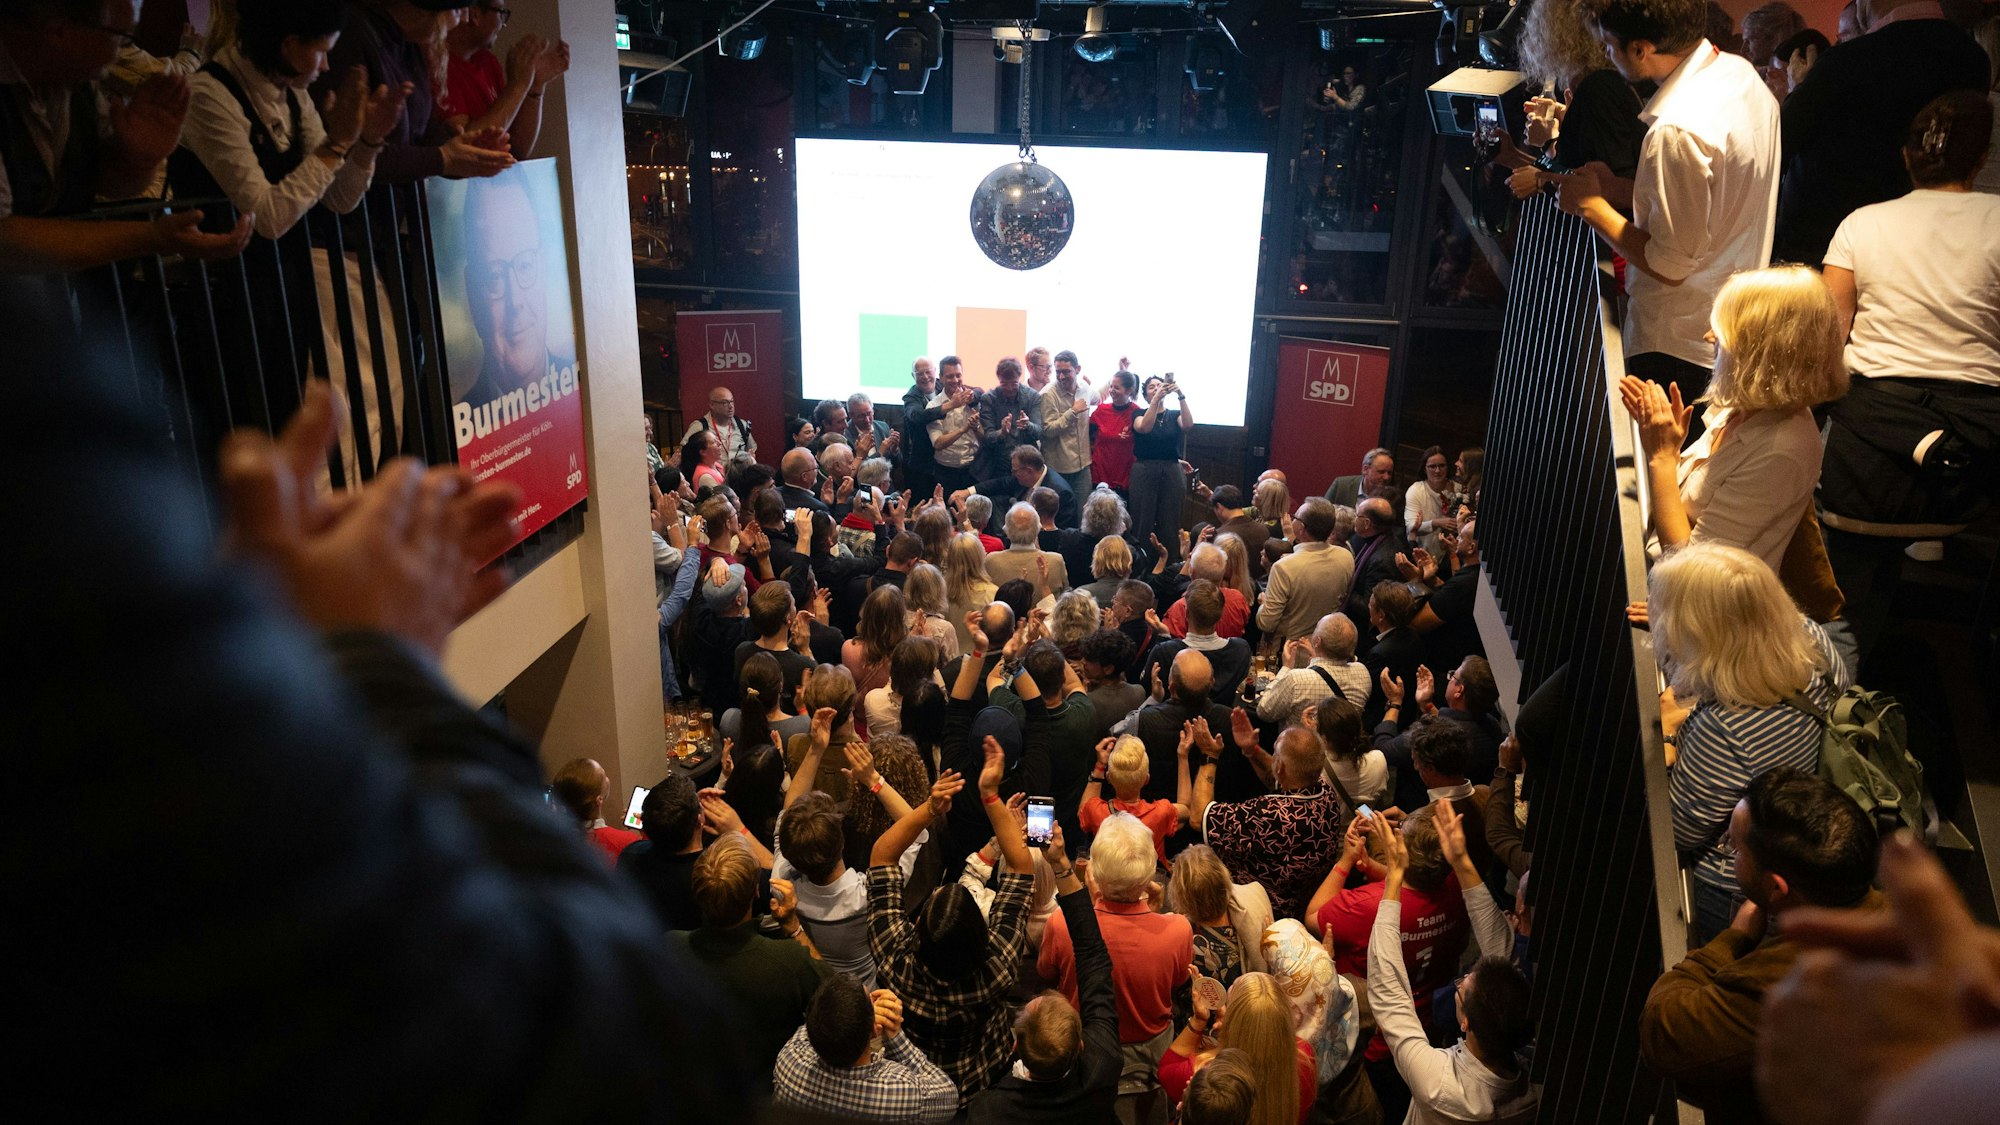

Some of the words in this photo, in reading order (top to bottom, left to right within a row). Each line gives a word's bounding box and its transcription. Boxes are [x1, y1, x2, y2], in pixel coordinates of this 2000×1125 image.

[713, 352, 752, 369] SPD
[1309, 380, 1350, 401] SPD
[453, 362, 580, 449] Burmester
[470, 458, 480, 470] Ihr
[480, 432, 532, 465] Oberbürgermeister
[532, 427, 541, 438] für
[566, 470, 582, 490] SPD
[518, 509, 528, 522] mit
[1416, 913, 1446, 928] Team
